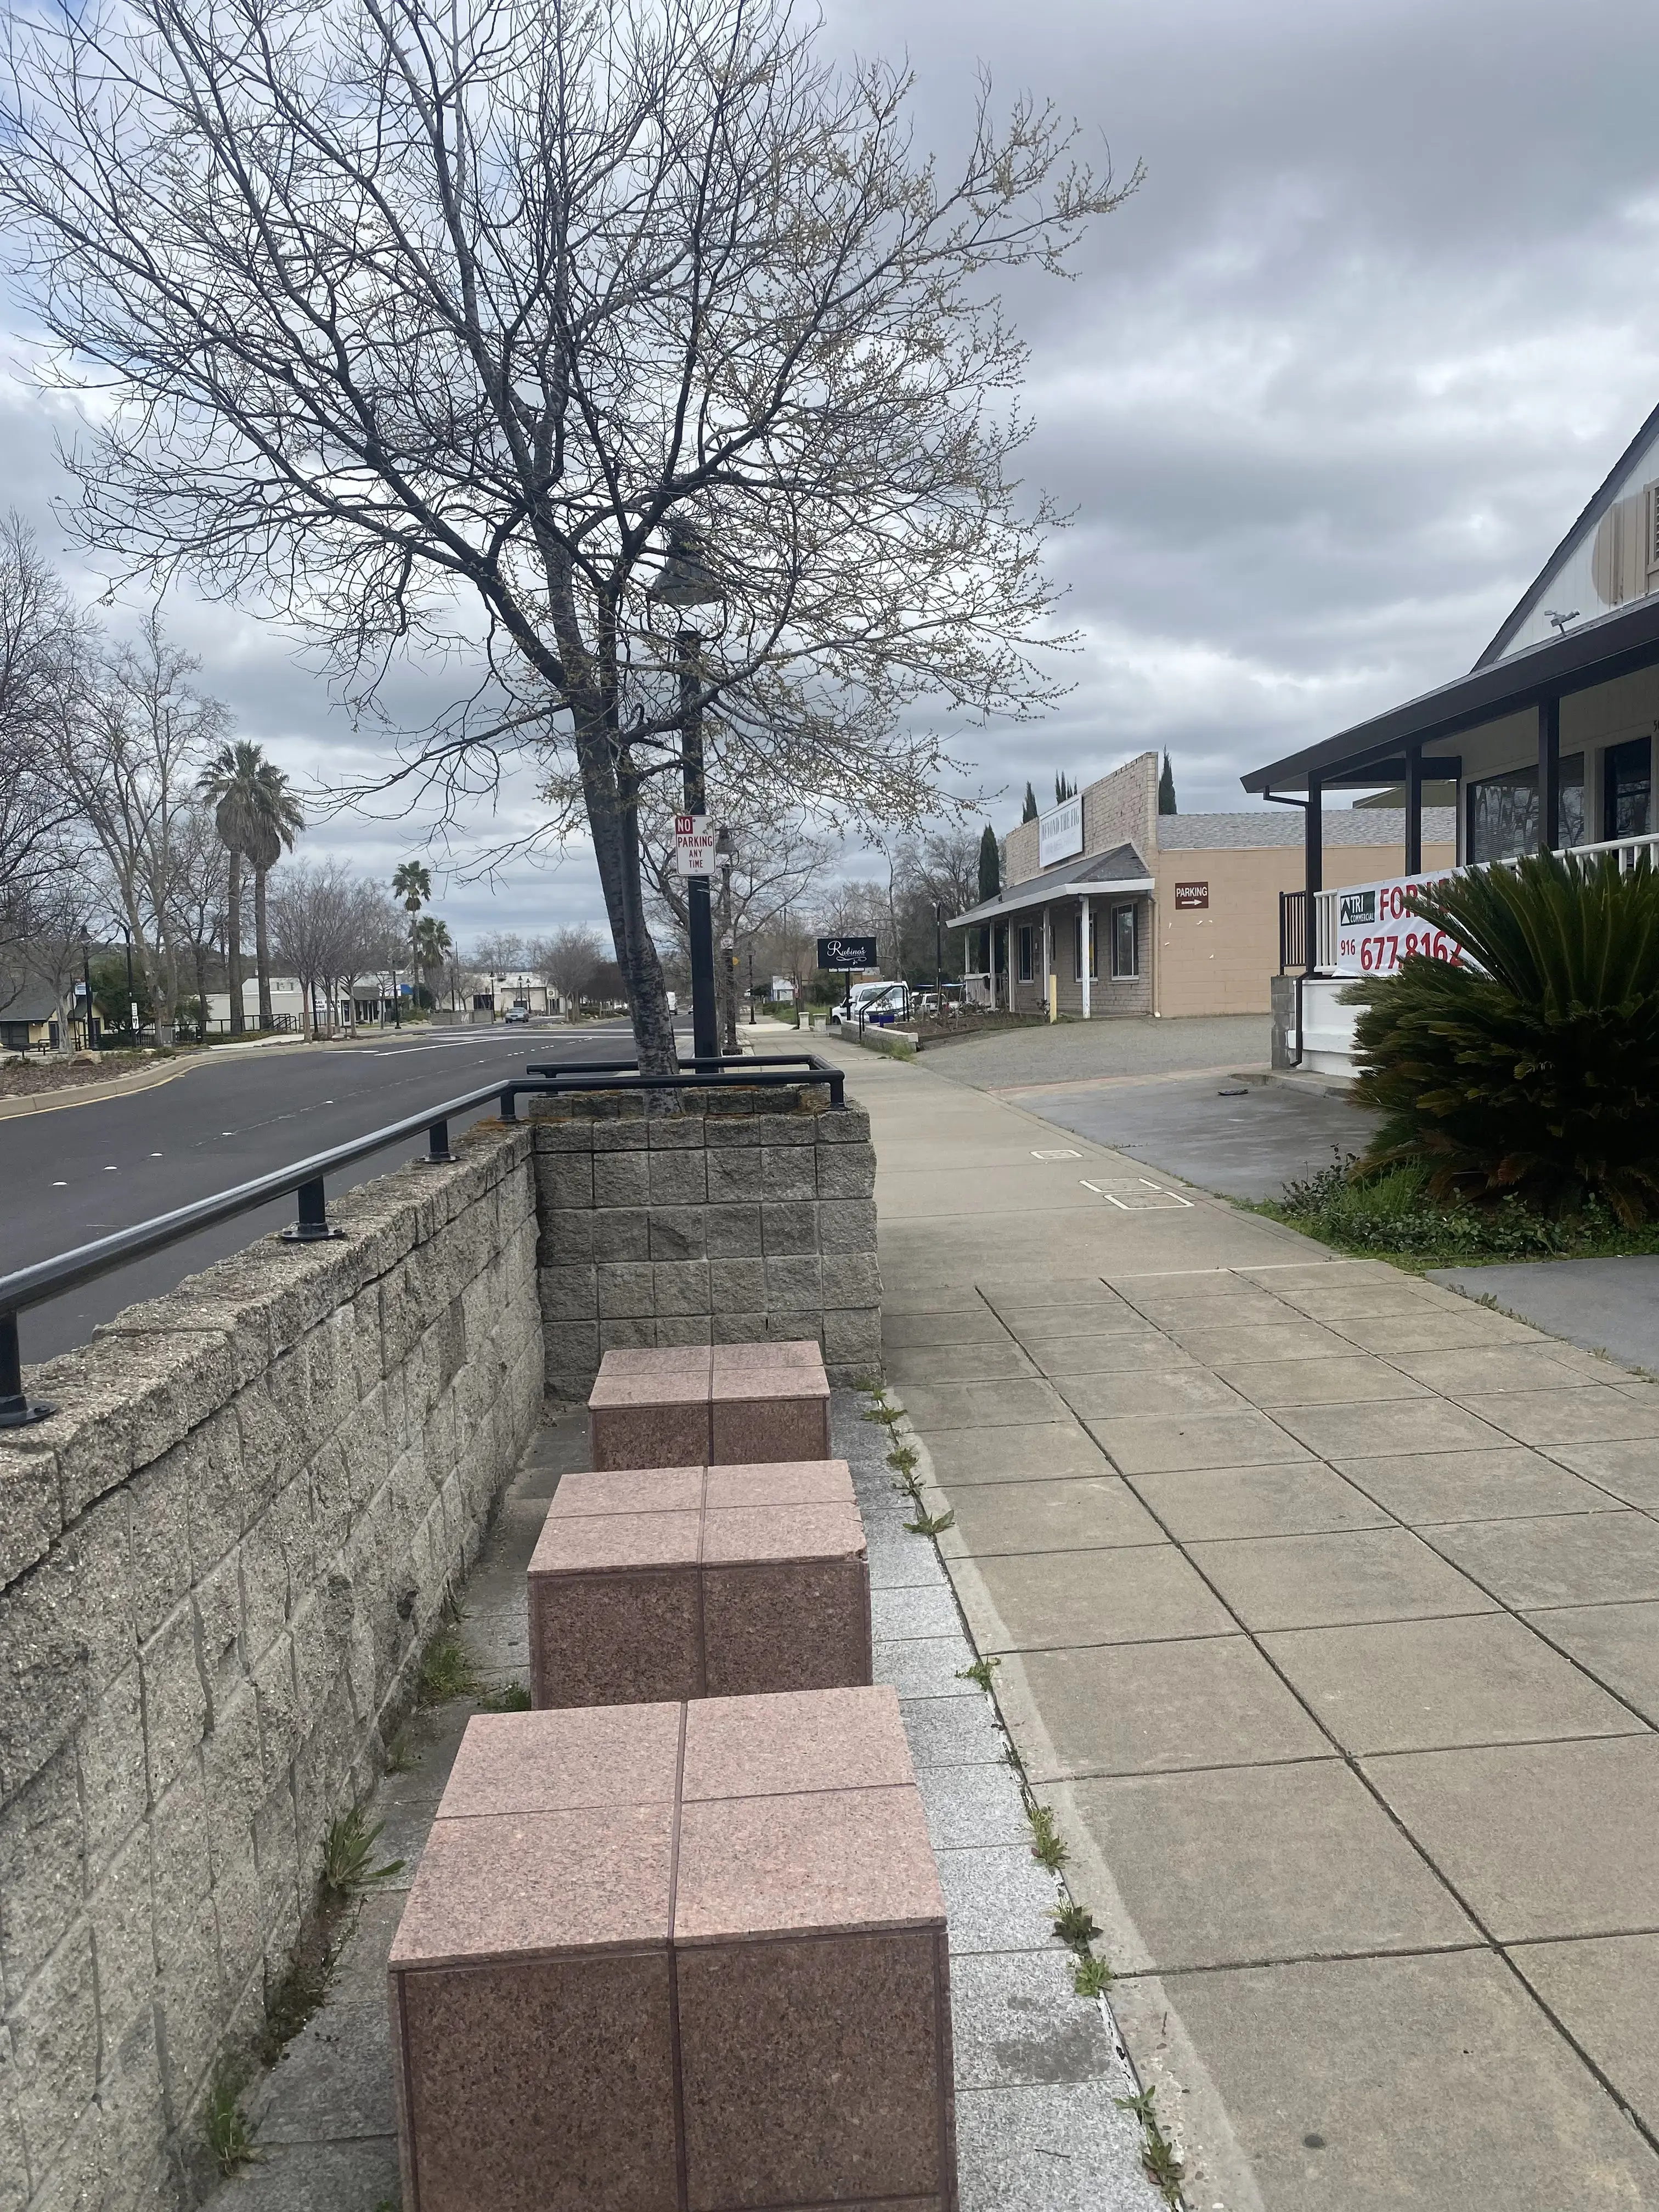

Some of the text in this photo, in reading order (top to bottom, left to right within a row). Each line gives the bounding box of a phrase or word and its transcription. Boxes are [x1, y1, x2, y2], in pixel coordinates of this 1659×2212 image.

[678, 819, 691, 832] NO
[1042, 806, 1080, 841] BEYOND THE FIG
[678, 836, 713, 848] PARKING
[689, 849, 702, 857] ANY
[689, 860, 703, 868] TIME
[1176, 887, 1207, 897] PARKING
[1350, 894, 1363, 913] TRI
[1350, 912, 1374, 923] COMMERCIAL
[1341, 939, 1355, 956] 916
